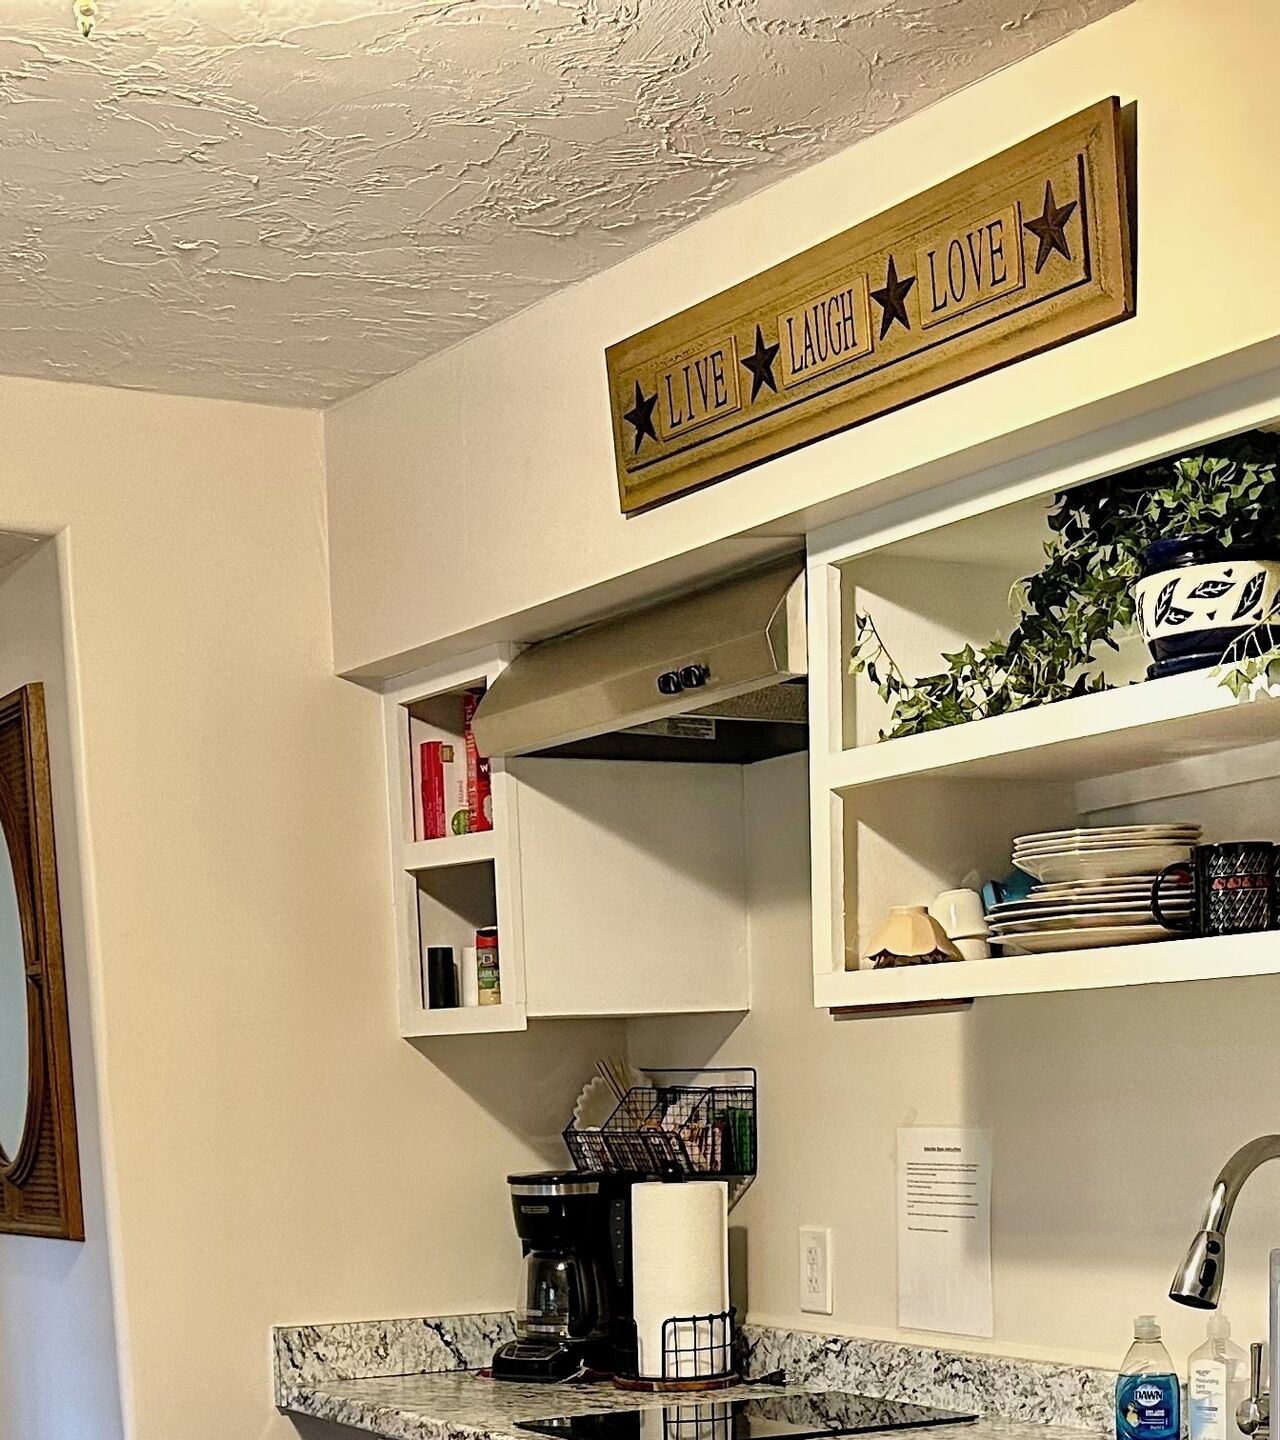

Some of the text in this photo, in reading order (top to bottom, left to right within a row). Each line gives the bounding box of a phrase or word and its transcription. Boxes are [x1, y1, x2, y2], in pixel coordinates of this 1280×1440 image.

[664, 218, 1008, 428] LIVE LAUGH LOVE
[1134, 1389, 1164, 1401] DAWN
